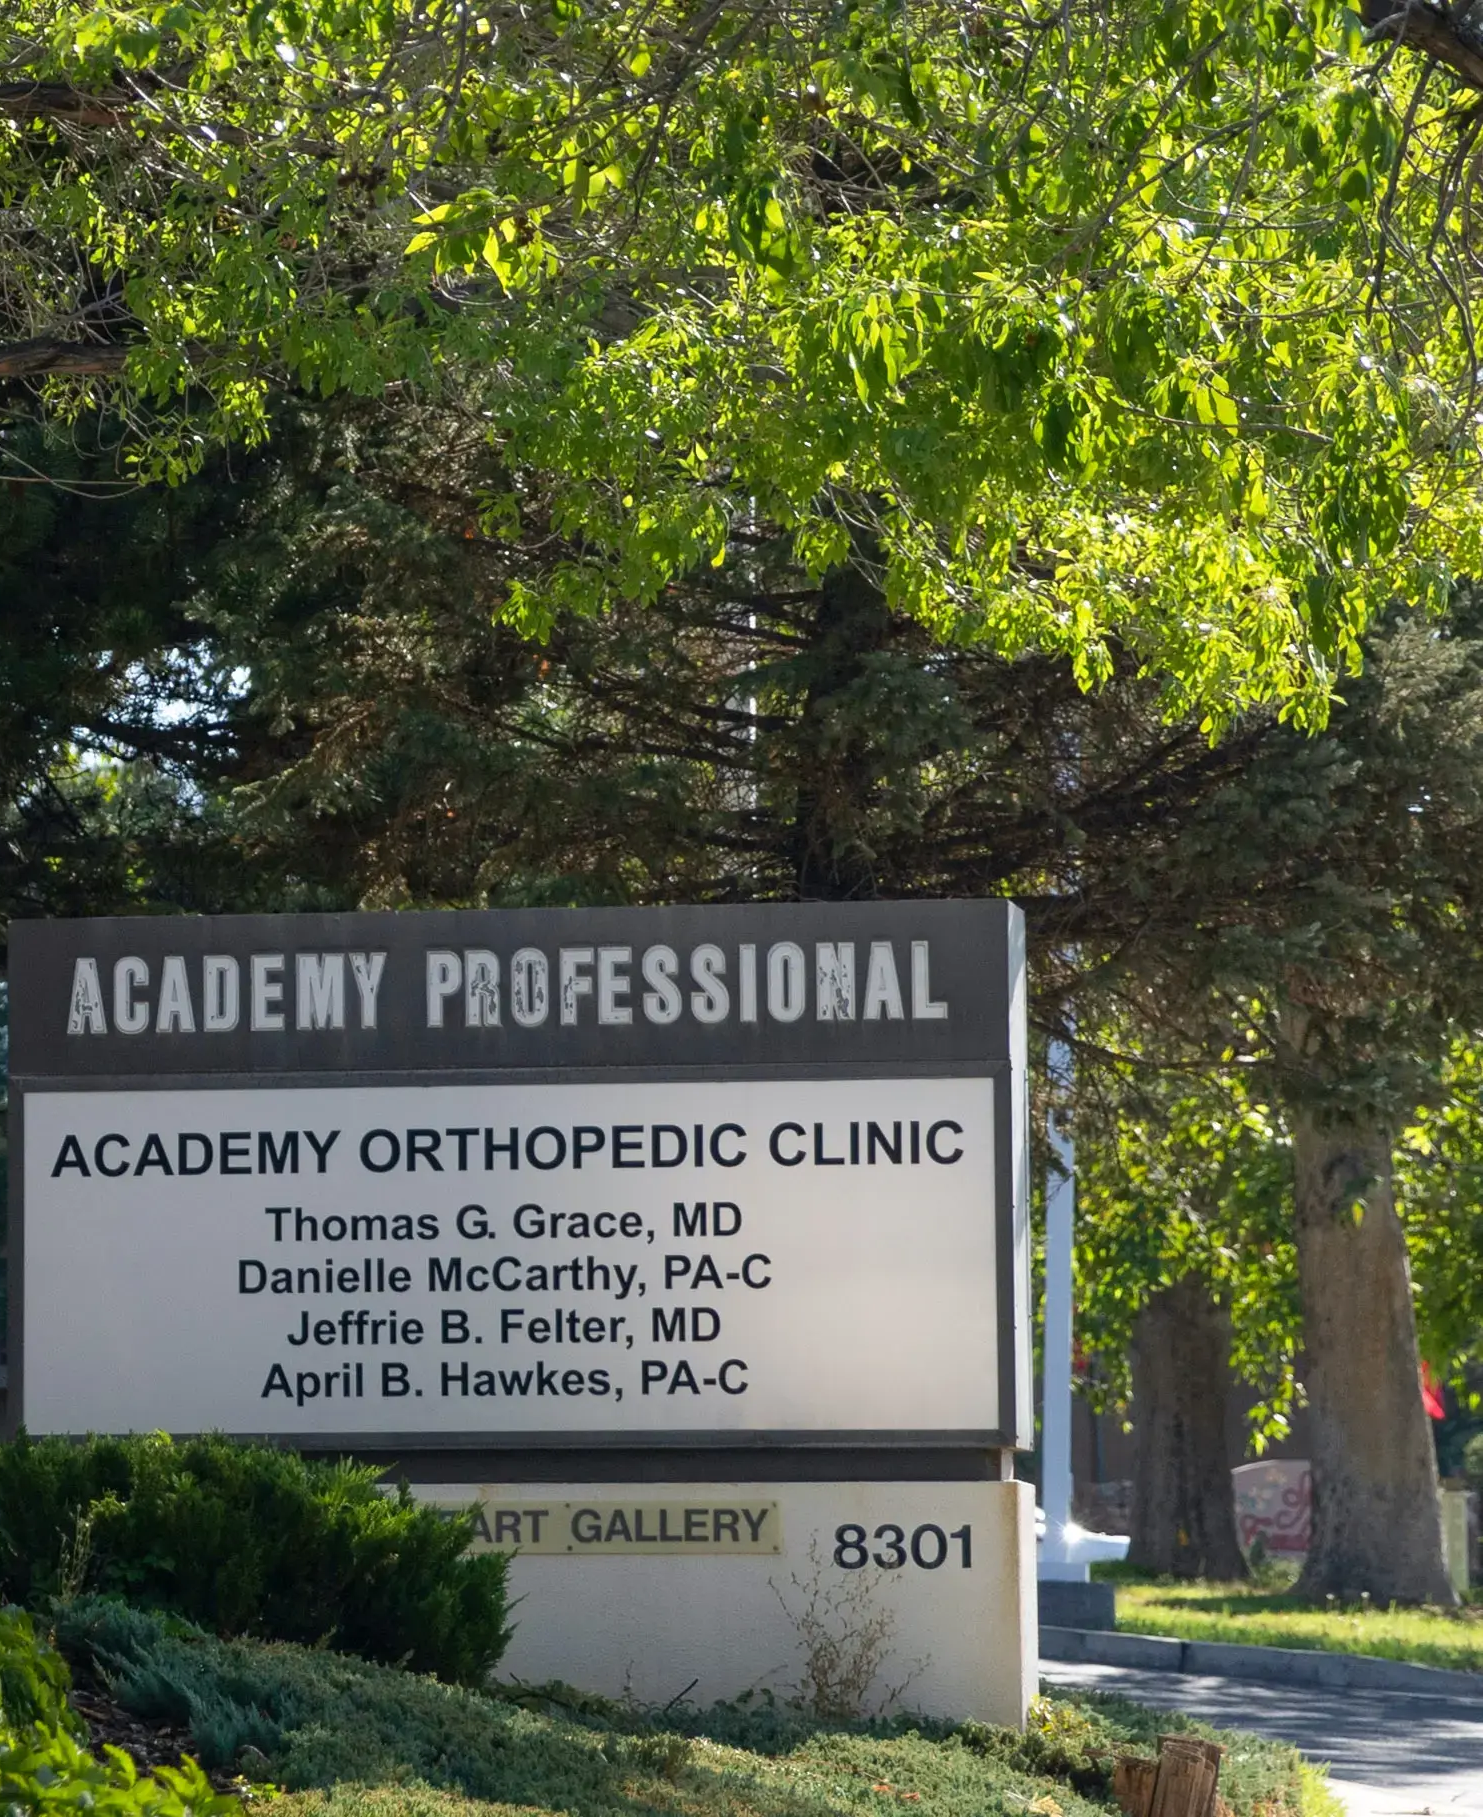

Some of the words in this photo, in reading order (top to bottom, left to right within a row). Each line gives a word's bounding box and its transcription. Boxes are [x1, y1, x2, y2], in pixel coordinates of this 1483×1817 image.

[66, 950, 387, 1036] ACADEMY
[426, 939, 949, 1029] PROFESSIONAL
[50, 1129, 342, 1178] ACADEMY
[359, 1122, 747, 1174] ORTHOPEDIC
[769, 1119, 964, 1167] CLINIC
[264, 1206, 440, 1243] Thomas
[455, 1203, 496, 1240] G.
[513, 1203, 655, 1246] Grace,
[673, 1201, 742, 1237] MD
[238, 1257, 412, 1295] Danielle
[428, 1255, 646, 1301] McCarthy,
[664, 1253, 772, 1290] PA-C
[286, 1309, 425, 1347] Jeffrie
[440, 1308, 483, 1345] B.
[500, 1308, 634, 1350] Felter,
[652, 1307, 721, 1343] MD
[260, 1362, 364, 1408] April
[381, 1361, 424, 1398] B.
[440, 1360, 623, 1404] Hawkes,
[641, 1358, 749, 1396] PA-C
[570, 1508, 769, 1544] GALLERY
[833, 1522, 973, 1570] 8301
